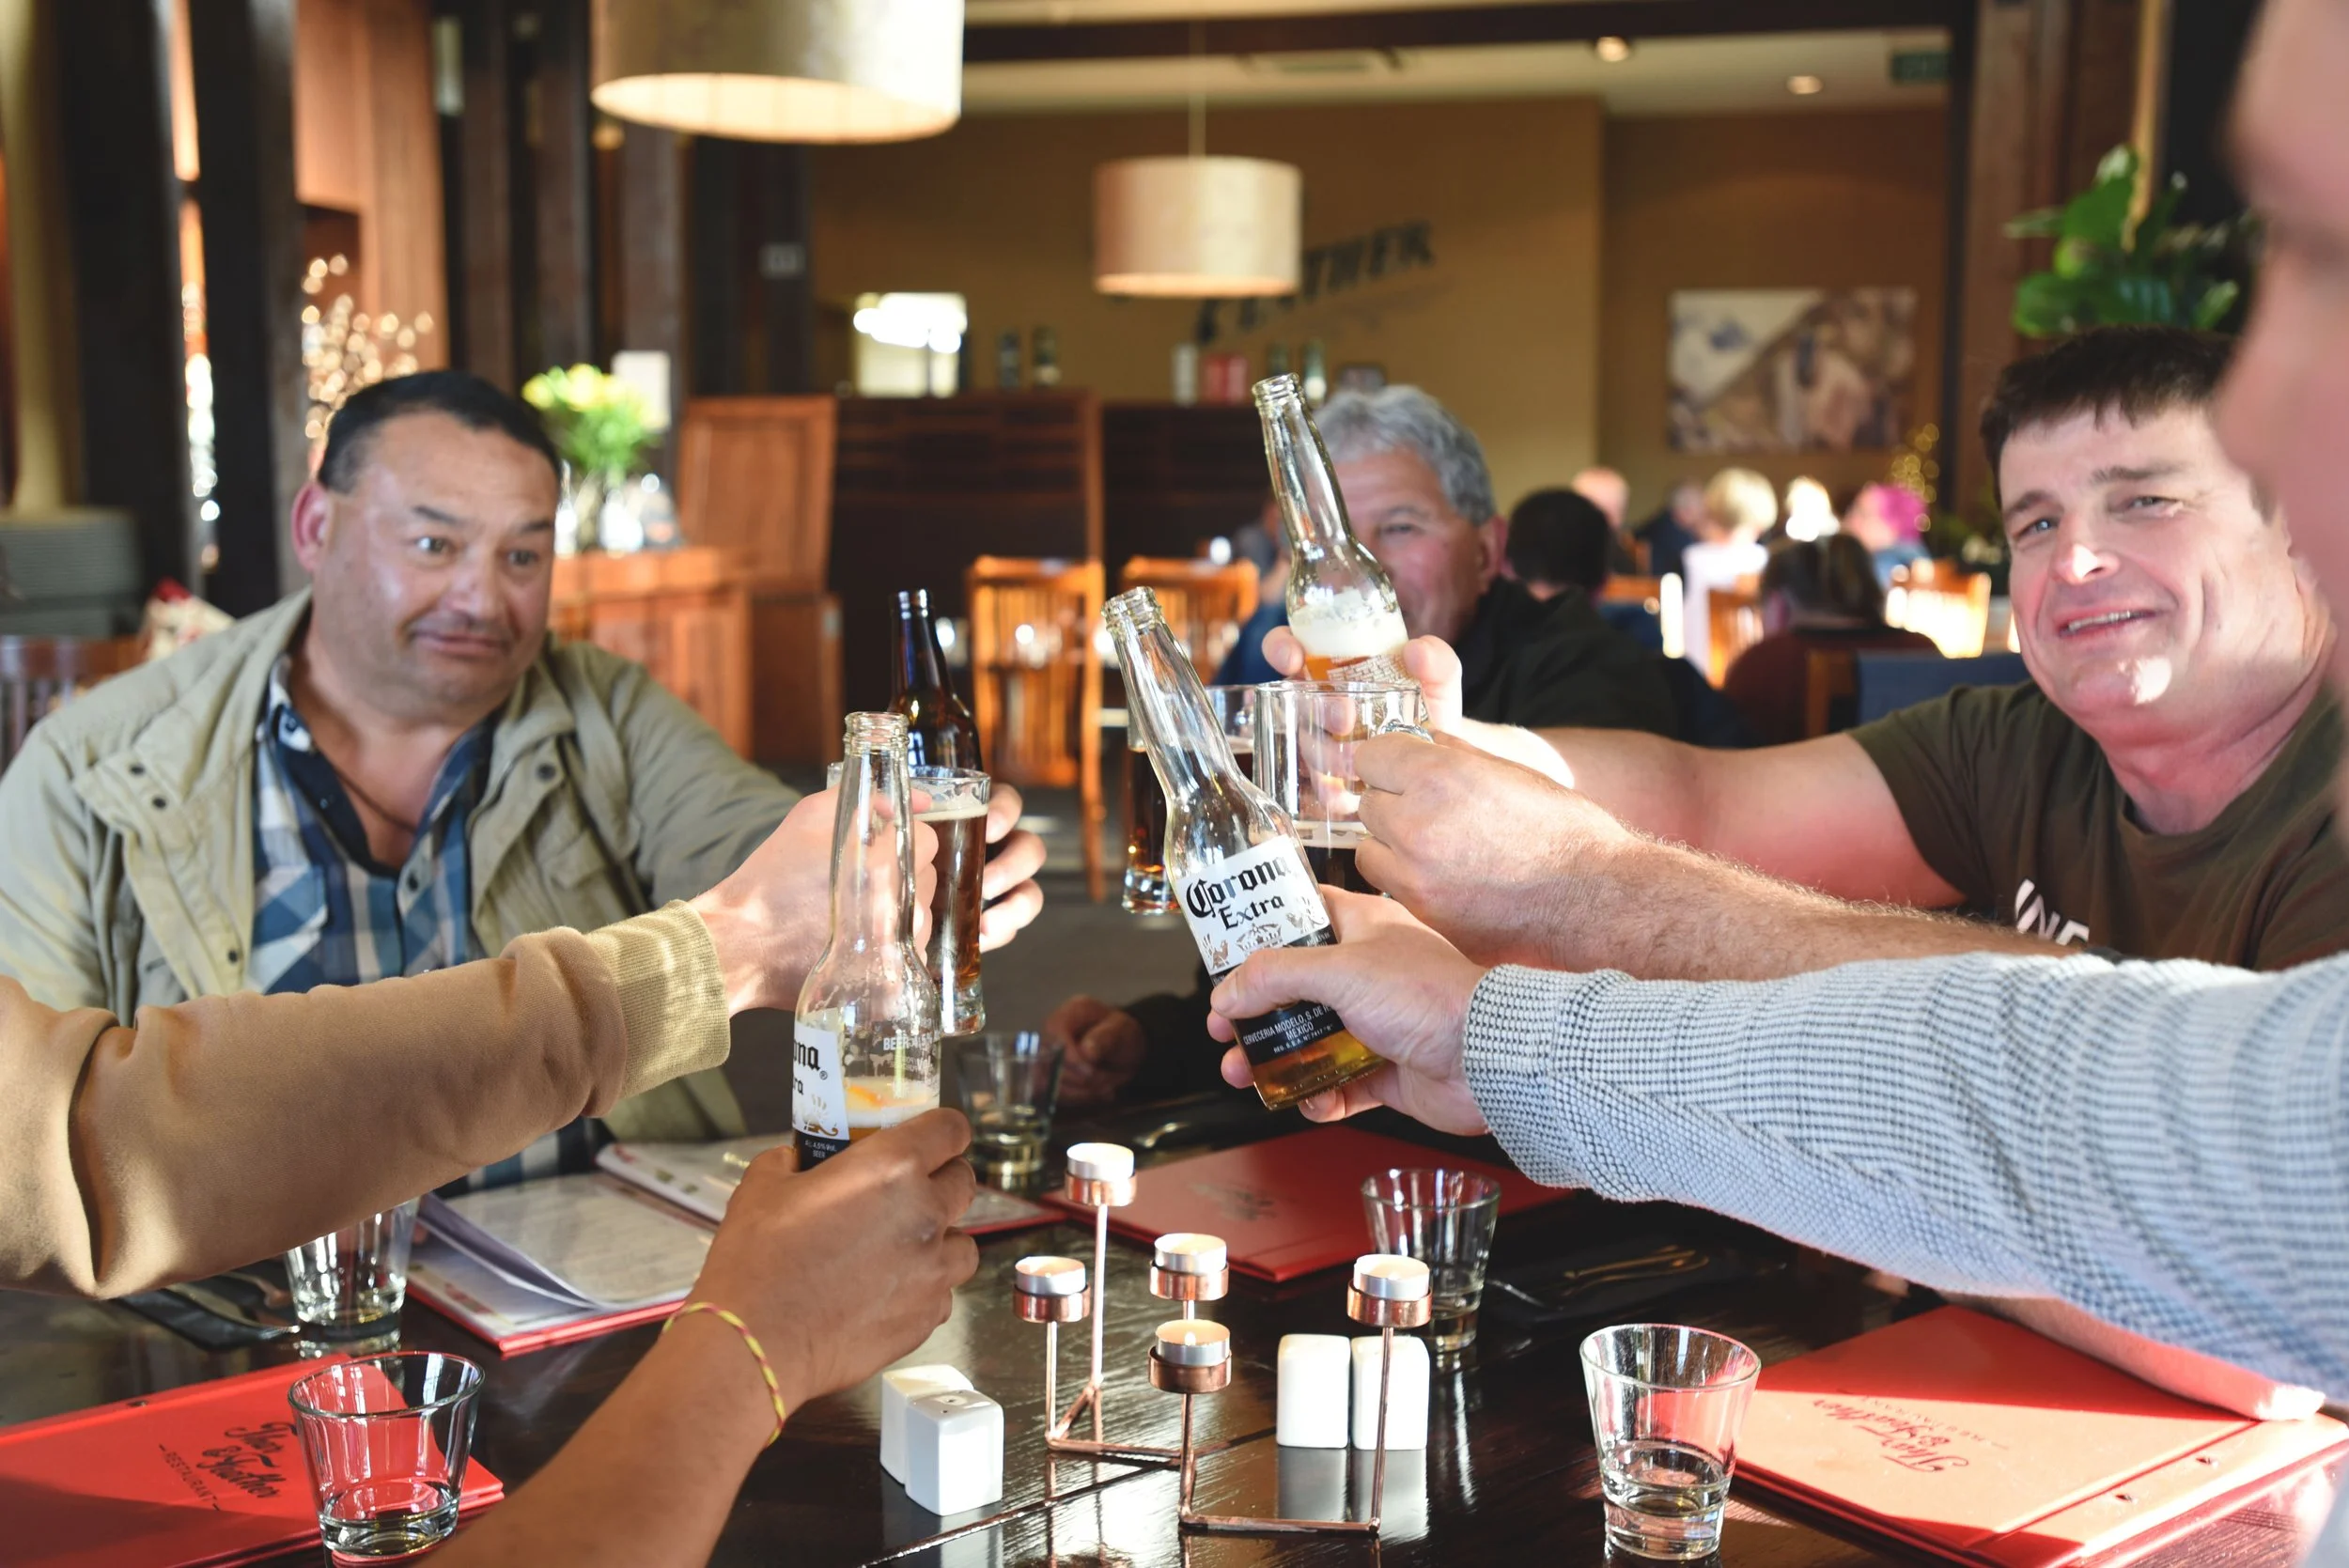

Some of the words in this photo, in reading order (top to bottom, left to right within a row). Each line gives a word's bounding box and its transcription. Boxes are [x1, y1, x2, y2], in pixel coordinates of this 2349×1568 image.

[1187, 856, 1291, 918] Corona
[1219, 895, 1284, 930] Extra
[1242, 1026, 1275, 1046] CERVECERIA
[1274, 1015, 1307, 1034] MODELO,
[1313, 1005, 1324, 1017] DE
[1285, 1021, 1315, 1041] MEXICO
